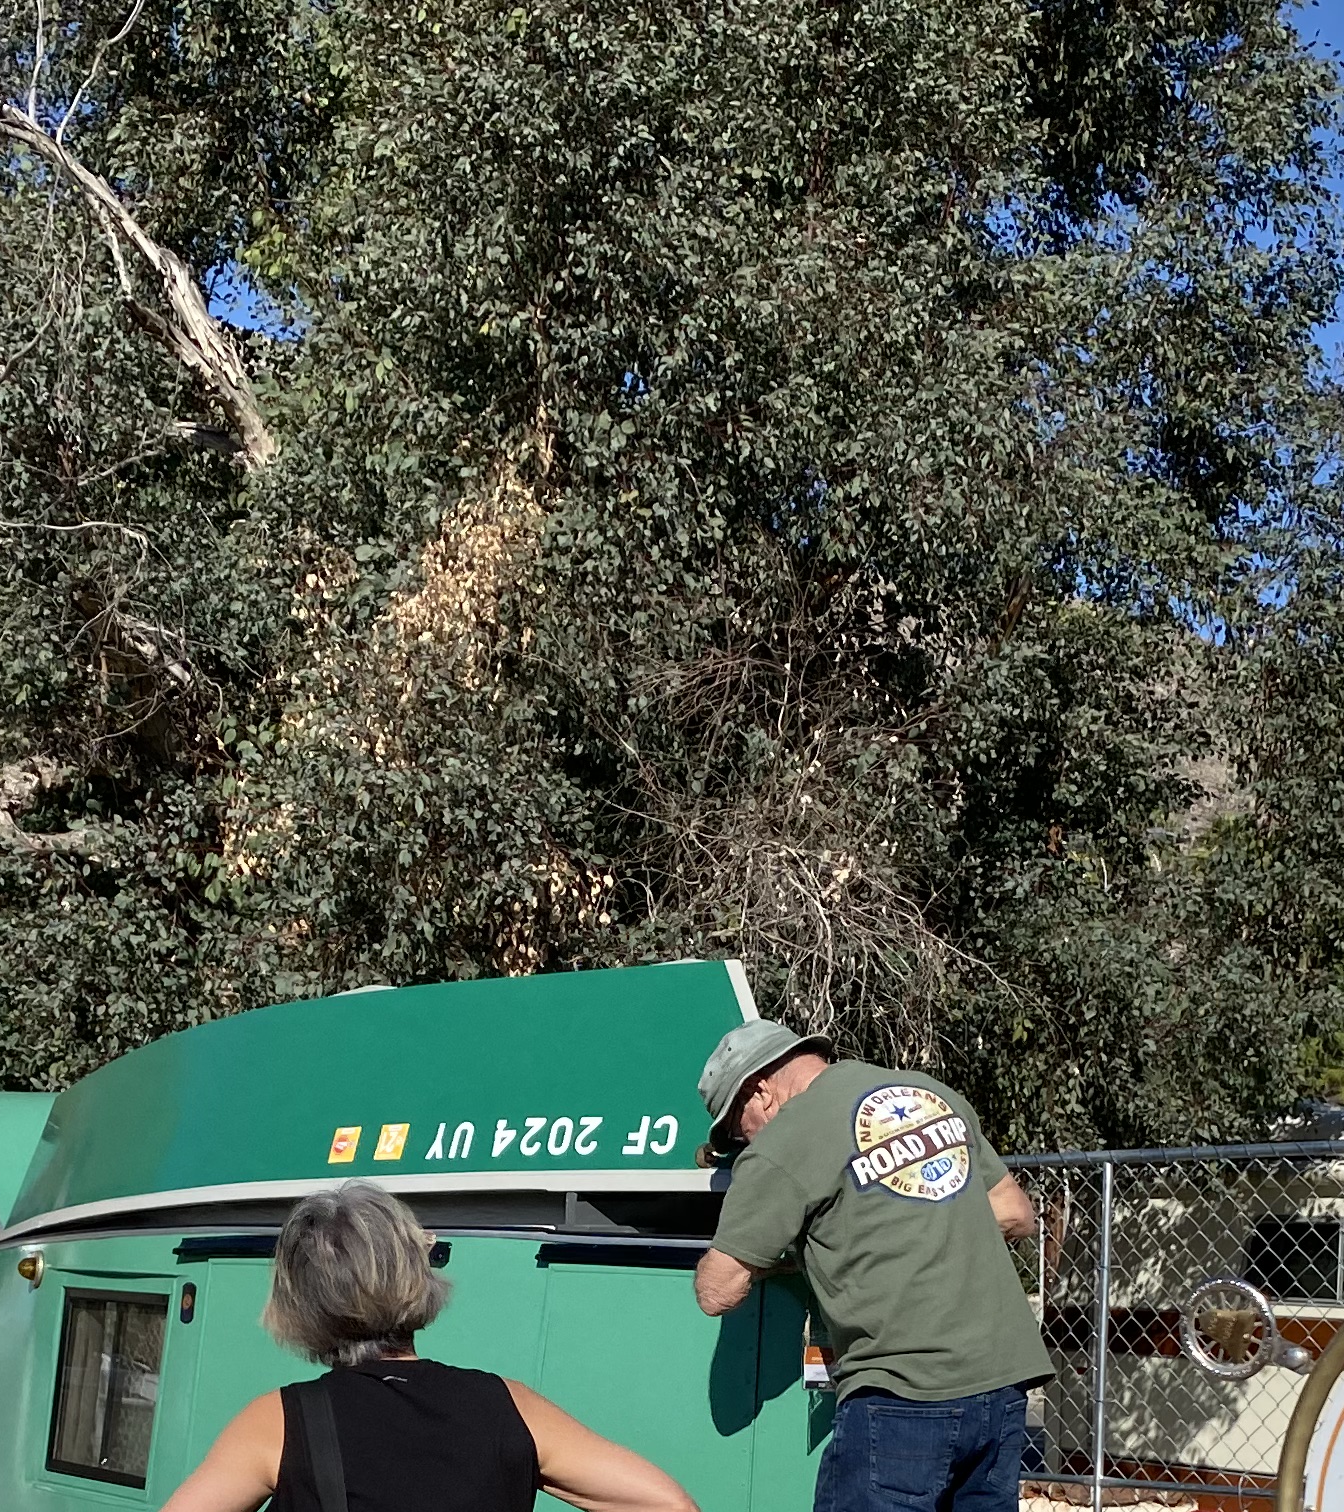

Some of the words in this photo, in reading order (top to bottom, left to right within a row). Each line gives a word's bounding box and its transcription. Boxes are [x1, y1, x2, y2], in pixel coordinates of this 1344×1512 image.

[424, 1121, 475, 1160] UY
[491, 1116, 604, 1158] 2024
[621, 1114, 679, 1155] CF
[851, 1133, 927, 1186] ROAD
[921, 1117, 967, 1150] TRIP
[891, 1176, 912, 1193] BIG
